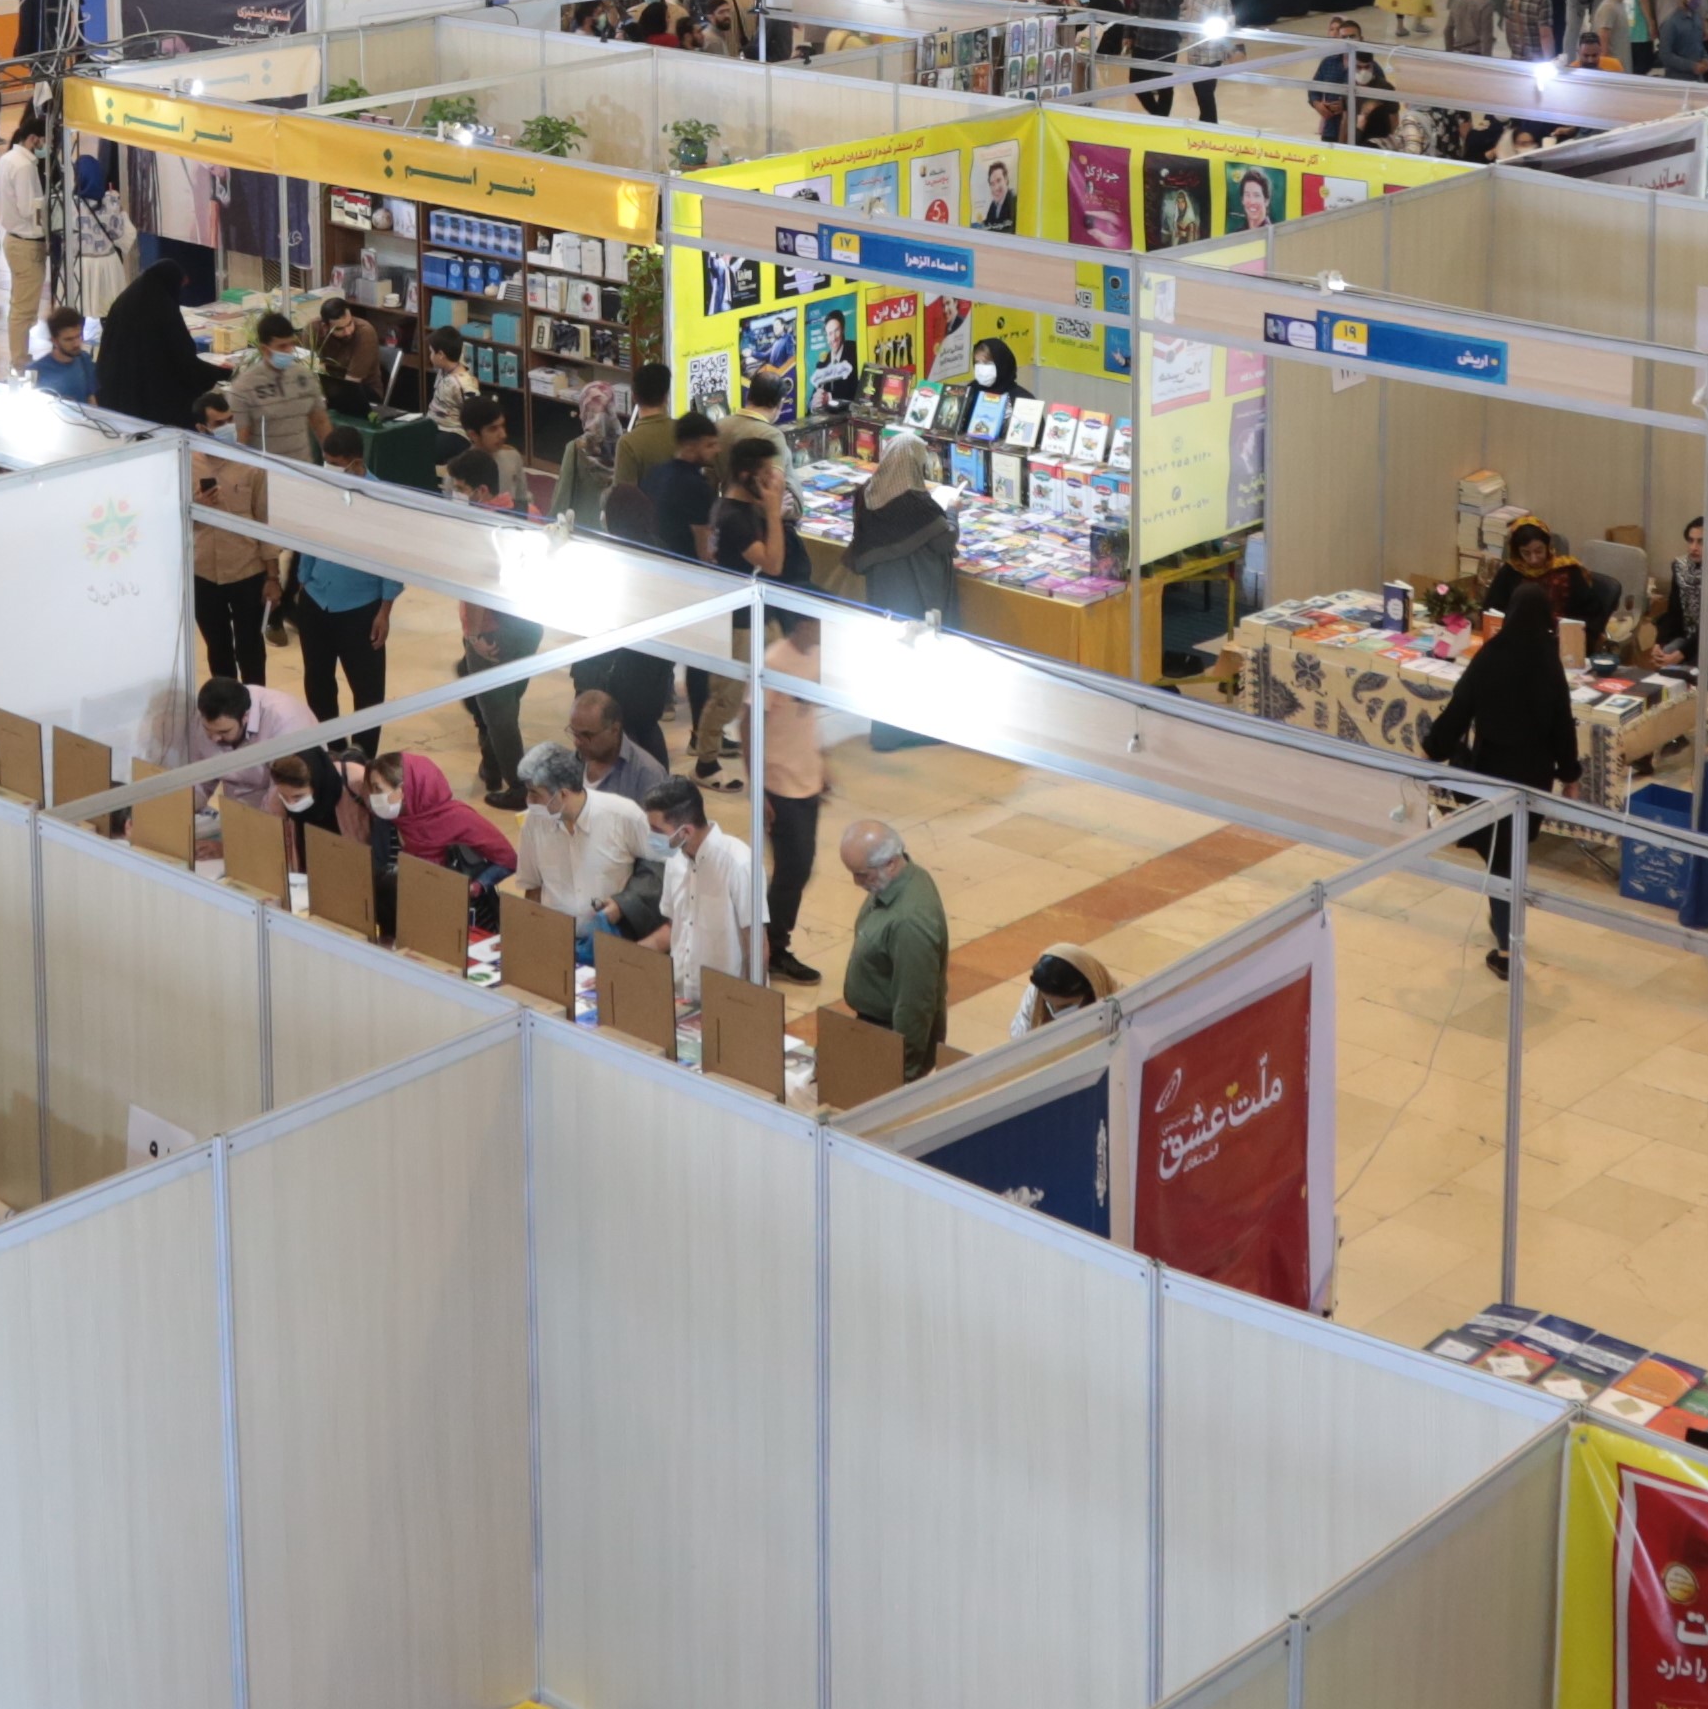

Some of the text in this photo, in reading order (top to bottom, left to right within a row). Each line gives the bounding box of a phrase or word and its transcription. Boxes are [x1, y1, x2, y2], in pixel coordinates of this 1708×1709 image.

[123, 113, 233, 144] نشر اسم
[405, 165, 536, 197] نشر اسم
[839, 235, 852, 249] ۱۷
[890, 297, 915, 320] زبان
[1343, 324, 1357, 339] ۱۹
[1158, 1102, 1227, 1180] عشق
[1656, 1655, 1694, 1682] دارد
[1694, 1660, 1708, 1684] را
